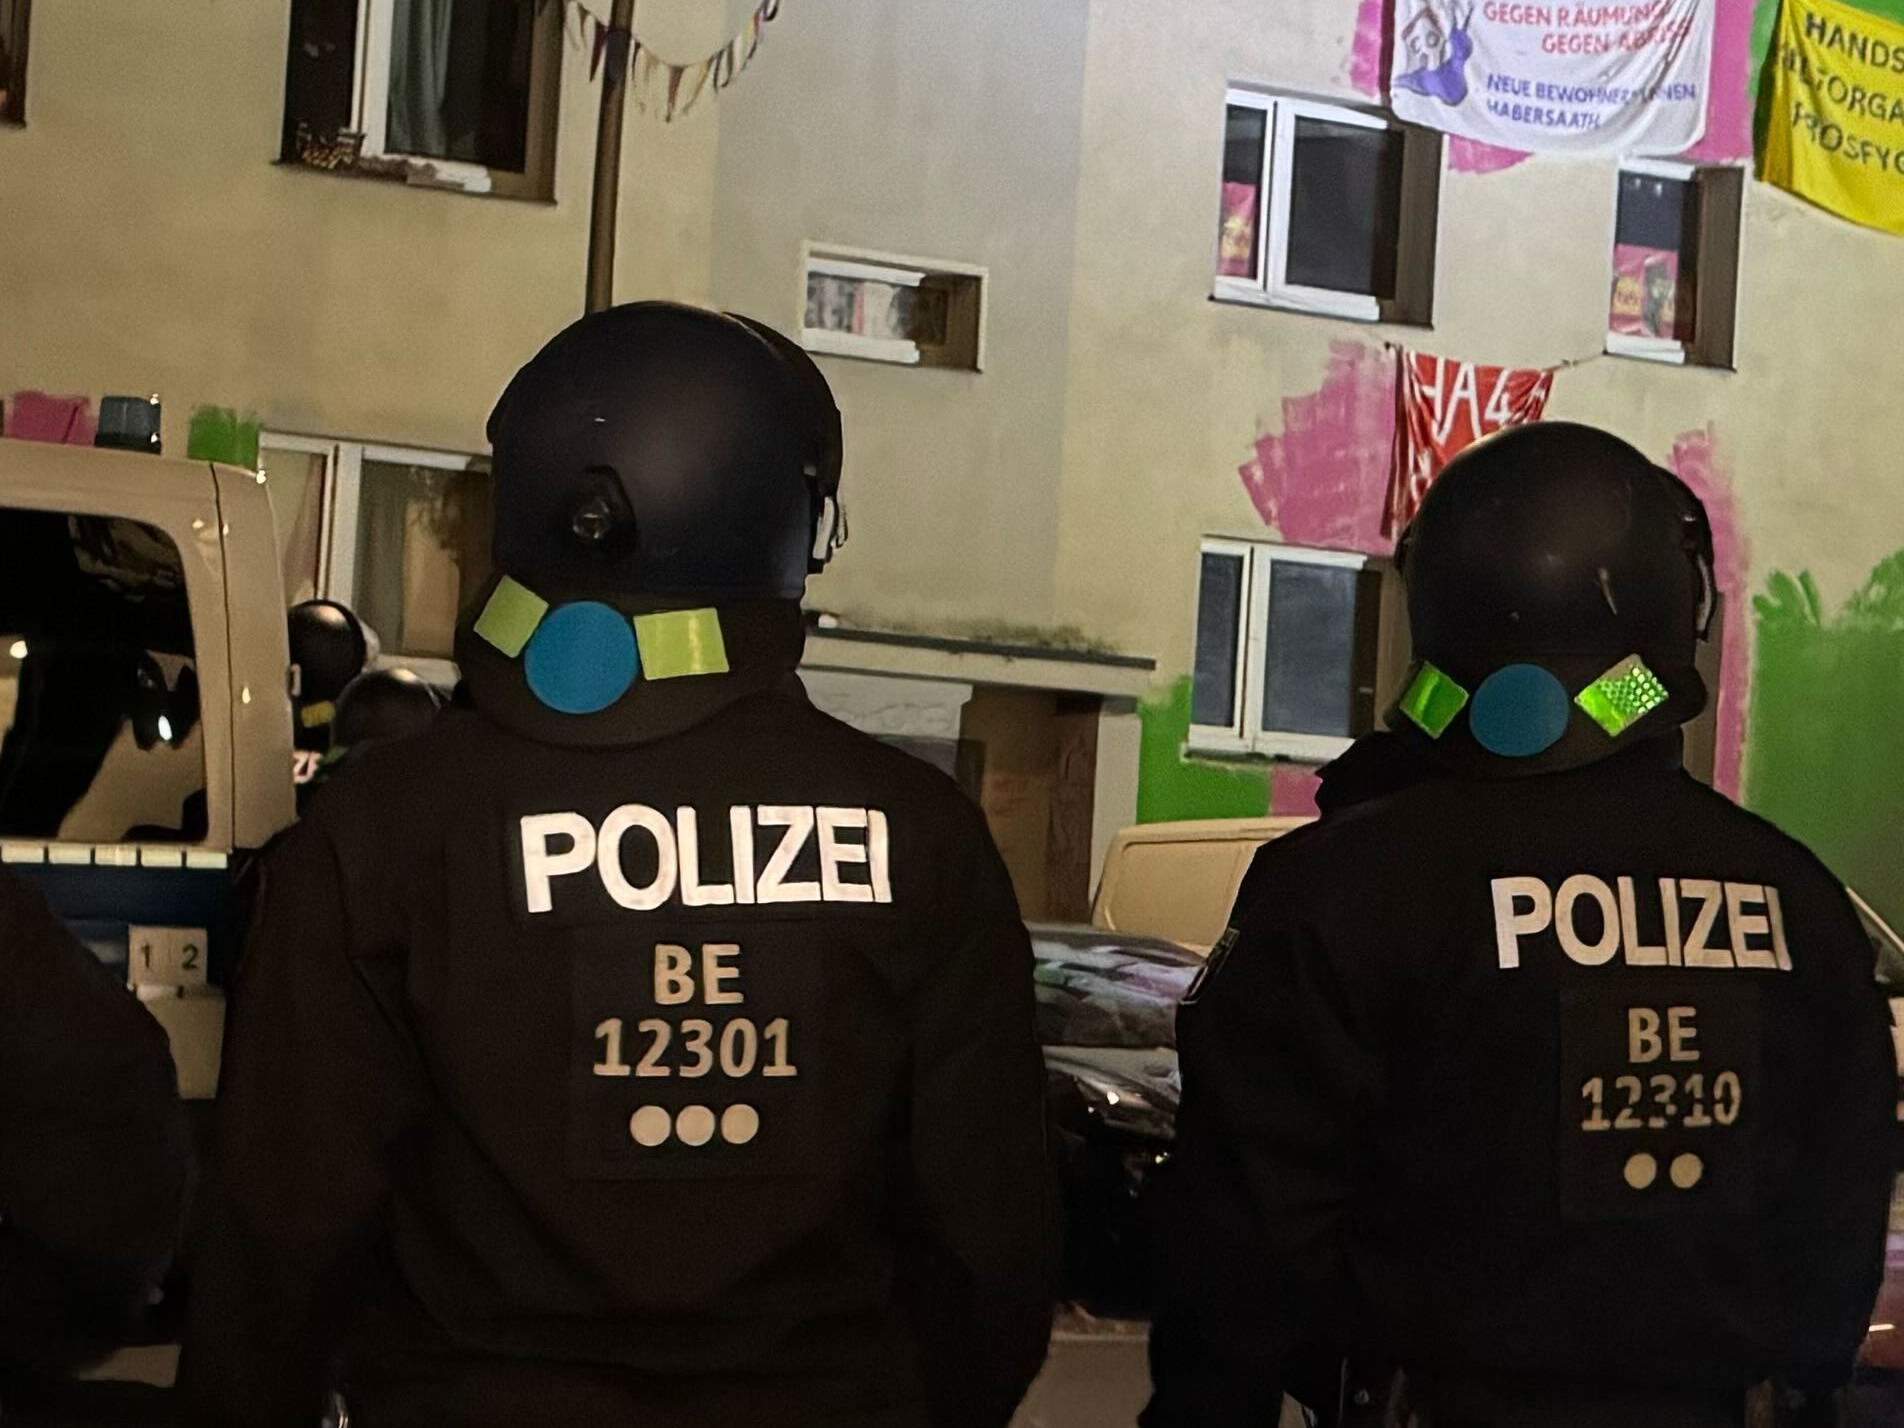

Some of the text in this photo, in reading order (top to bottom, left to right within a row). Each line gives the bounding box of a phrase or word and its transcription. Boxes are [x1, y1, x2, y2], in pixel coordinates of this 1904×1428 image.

[1483, 0, 1550, 26] GEGEN
[1541, 32, 1609, 54] GEGEN
[1487, 73, 1531, 98] NEUE
[520, 803, 893, 913] POLIZEI
[1490, 874, 1793, 971] POLIZEI
[653, 943, 744, 1005] BE
[593, 1017, 798, 1077] 12301
[1627, 1006, 1700, 1064] BE
[1580, 1070, 1743, 1132] 12310
